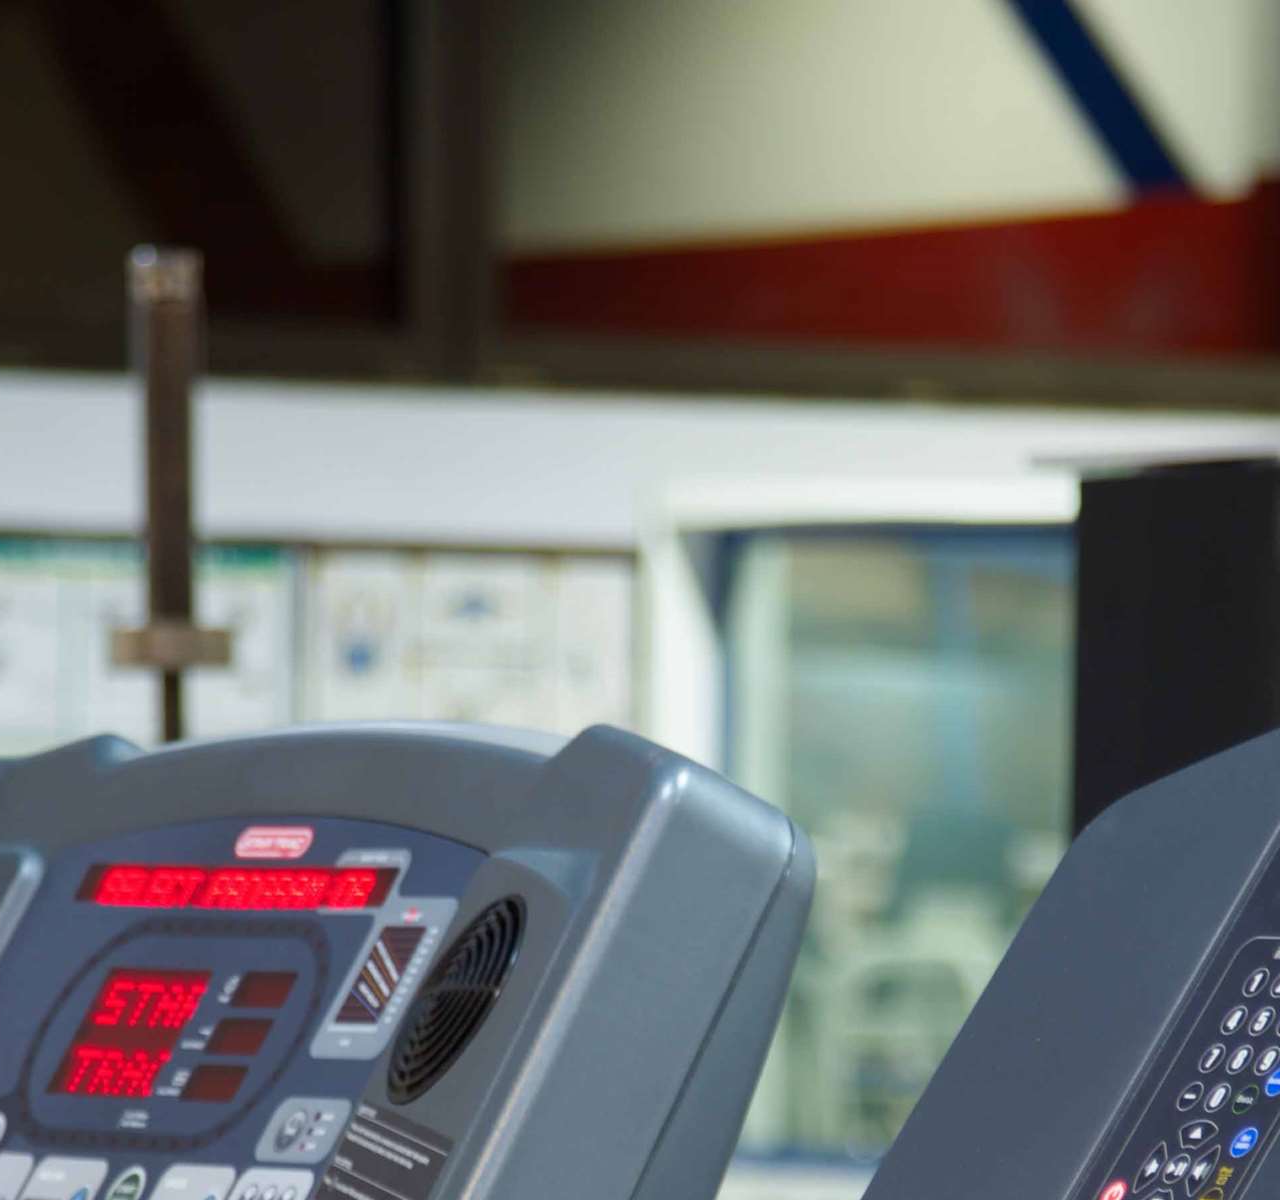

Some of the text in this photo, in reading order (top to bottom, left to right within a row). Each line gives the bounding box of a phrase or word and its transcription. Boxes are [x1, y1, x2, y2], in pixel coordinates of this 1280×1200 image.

[1250, 974, 1264, 992] 1
[1226, 1011, 1243, 1030] 4
[1254, 1013, 1271, 1031] 5
[1206, 1050, 1277, 1072] 7 8 9
[1209, 1087, 1226, 1108] 0
